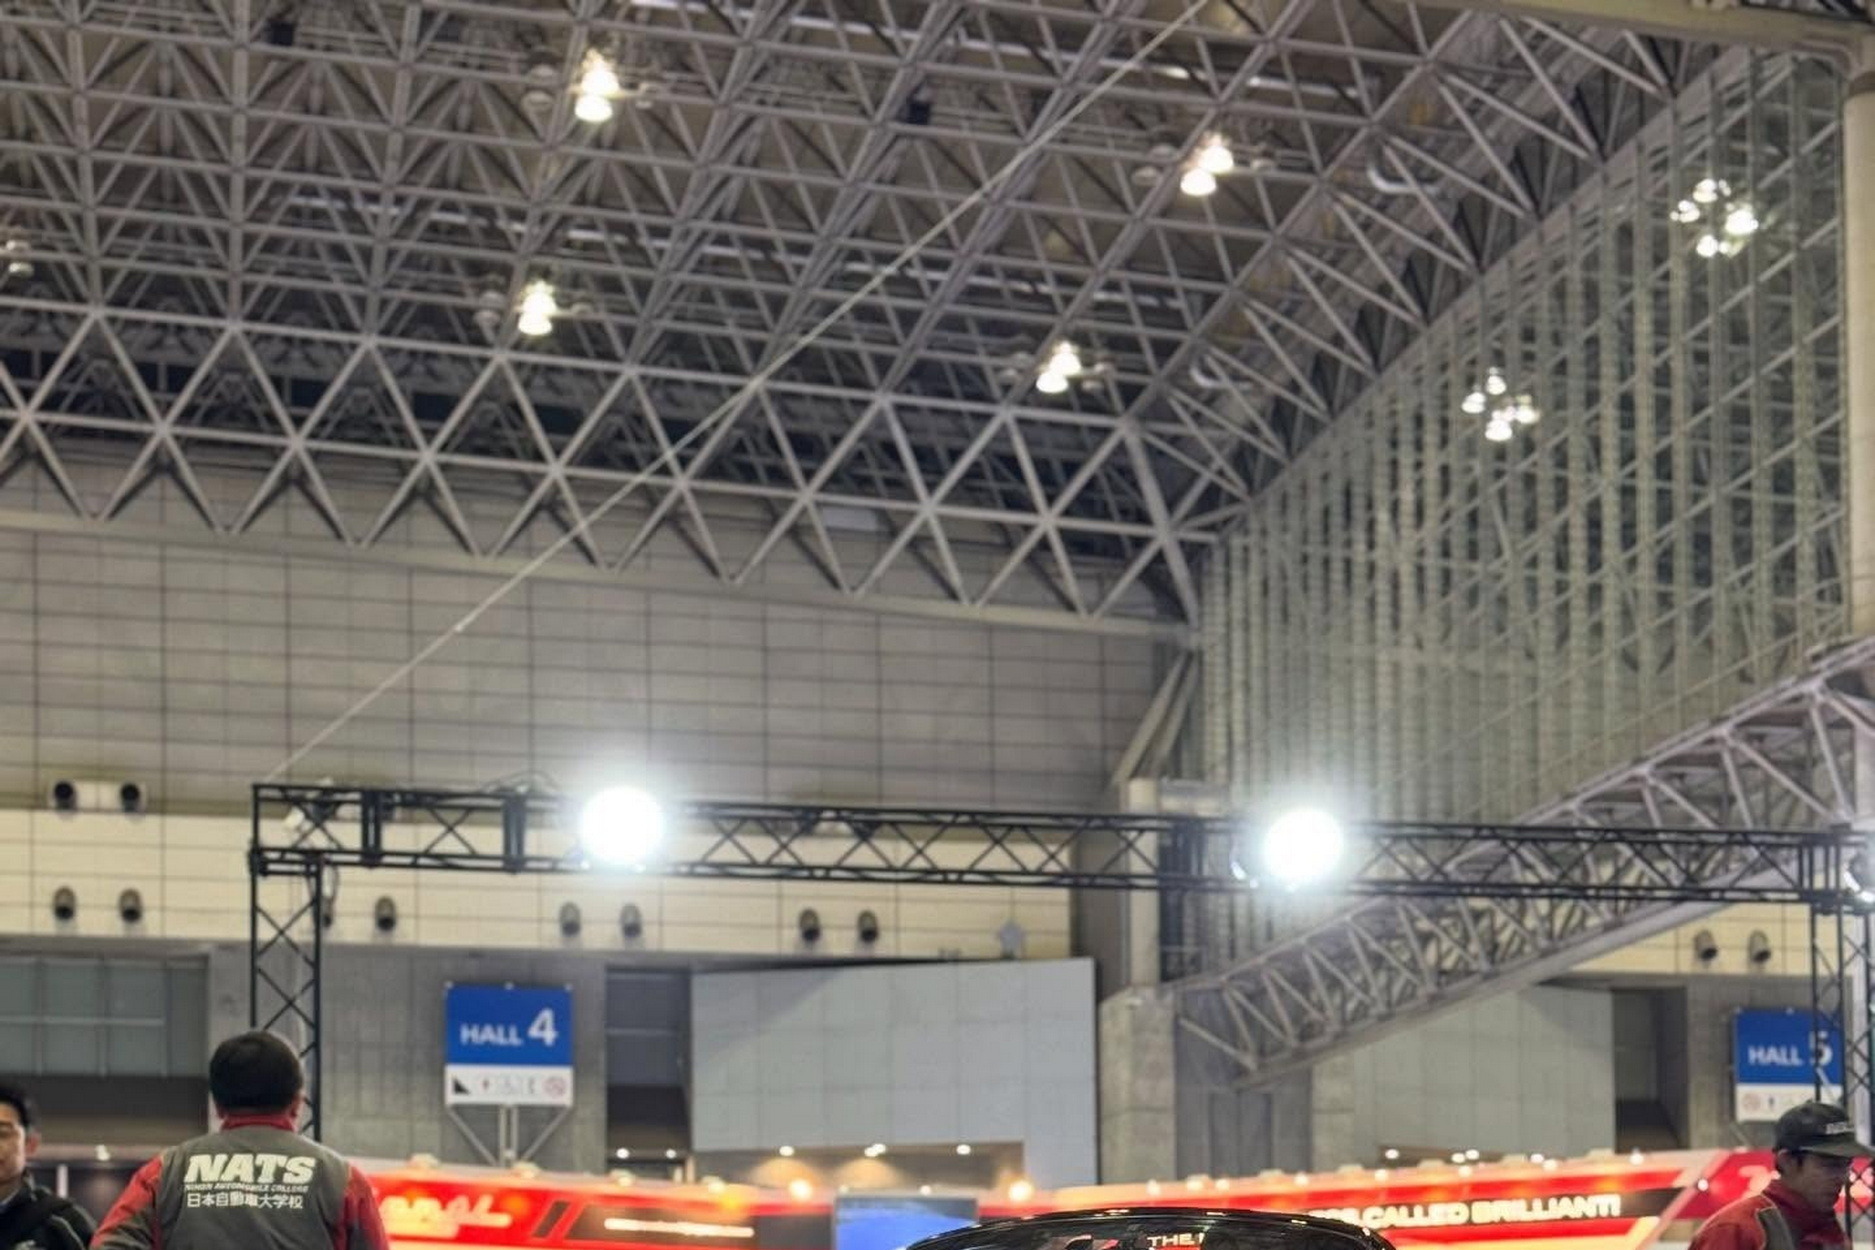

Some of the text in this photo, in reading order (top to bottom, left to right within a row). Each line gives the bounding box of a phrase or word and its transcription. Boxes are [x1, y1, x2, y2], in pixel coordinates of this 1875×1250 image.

[460, 1007, 558, 1047] HALL 4
[1747, 1030, 1833, 1067] HALL 5
[184, 1153, 316, 1184] NATS
[187, 1191, 303, 1209] 日本自動車大学校
[1363, 1203, 1469, 1229] CALLED
